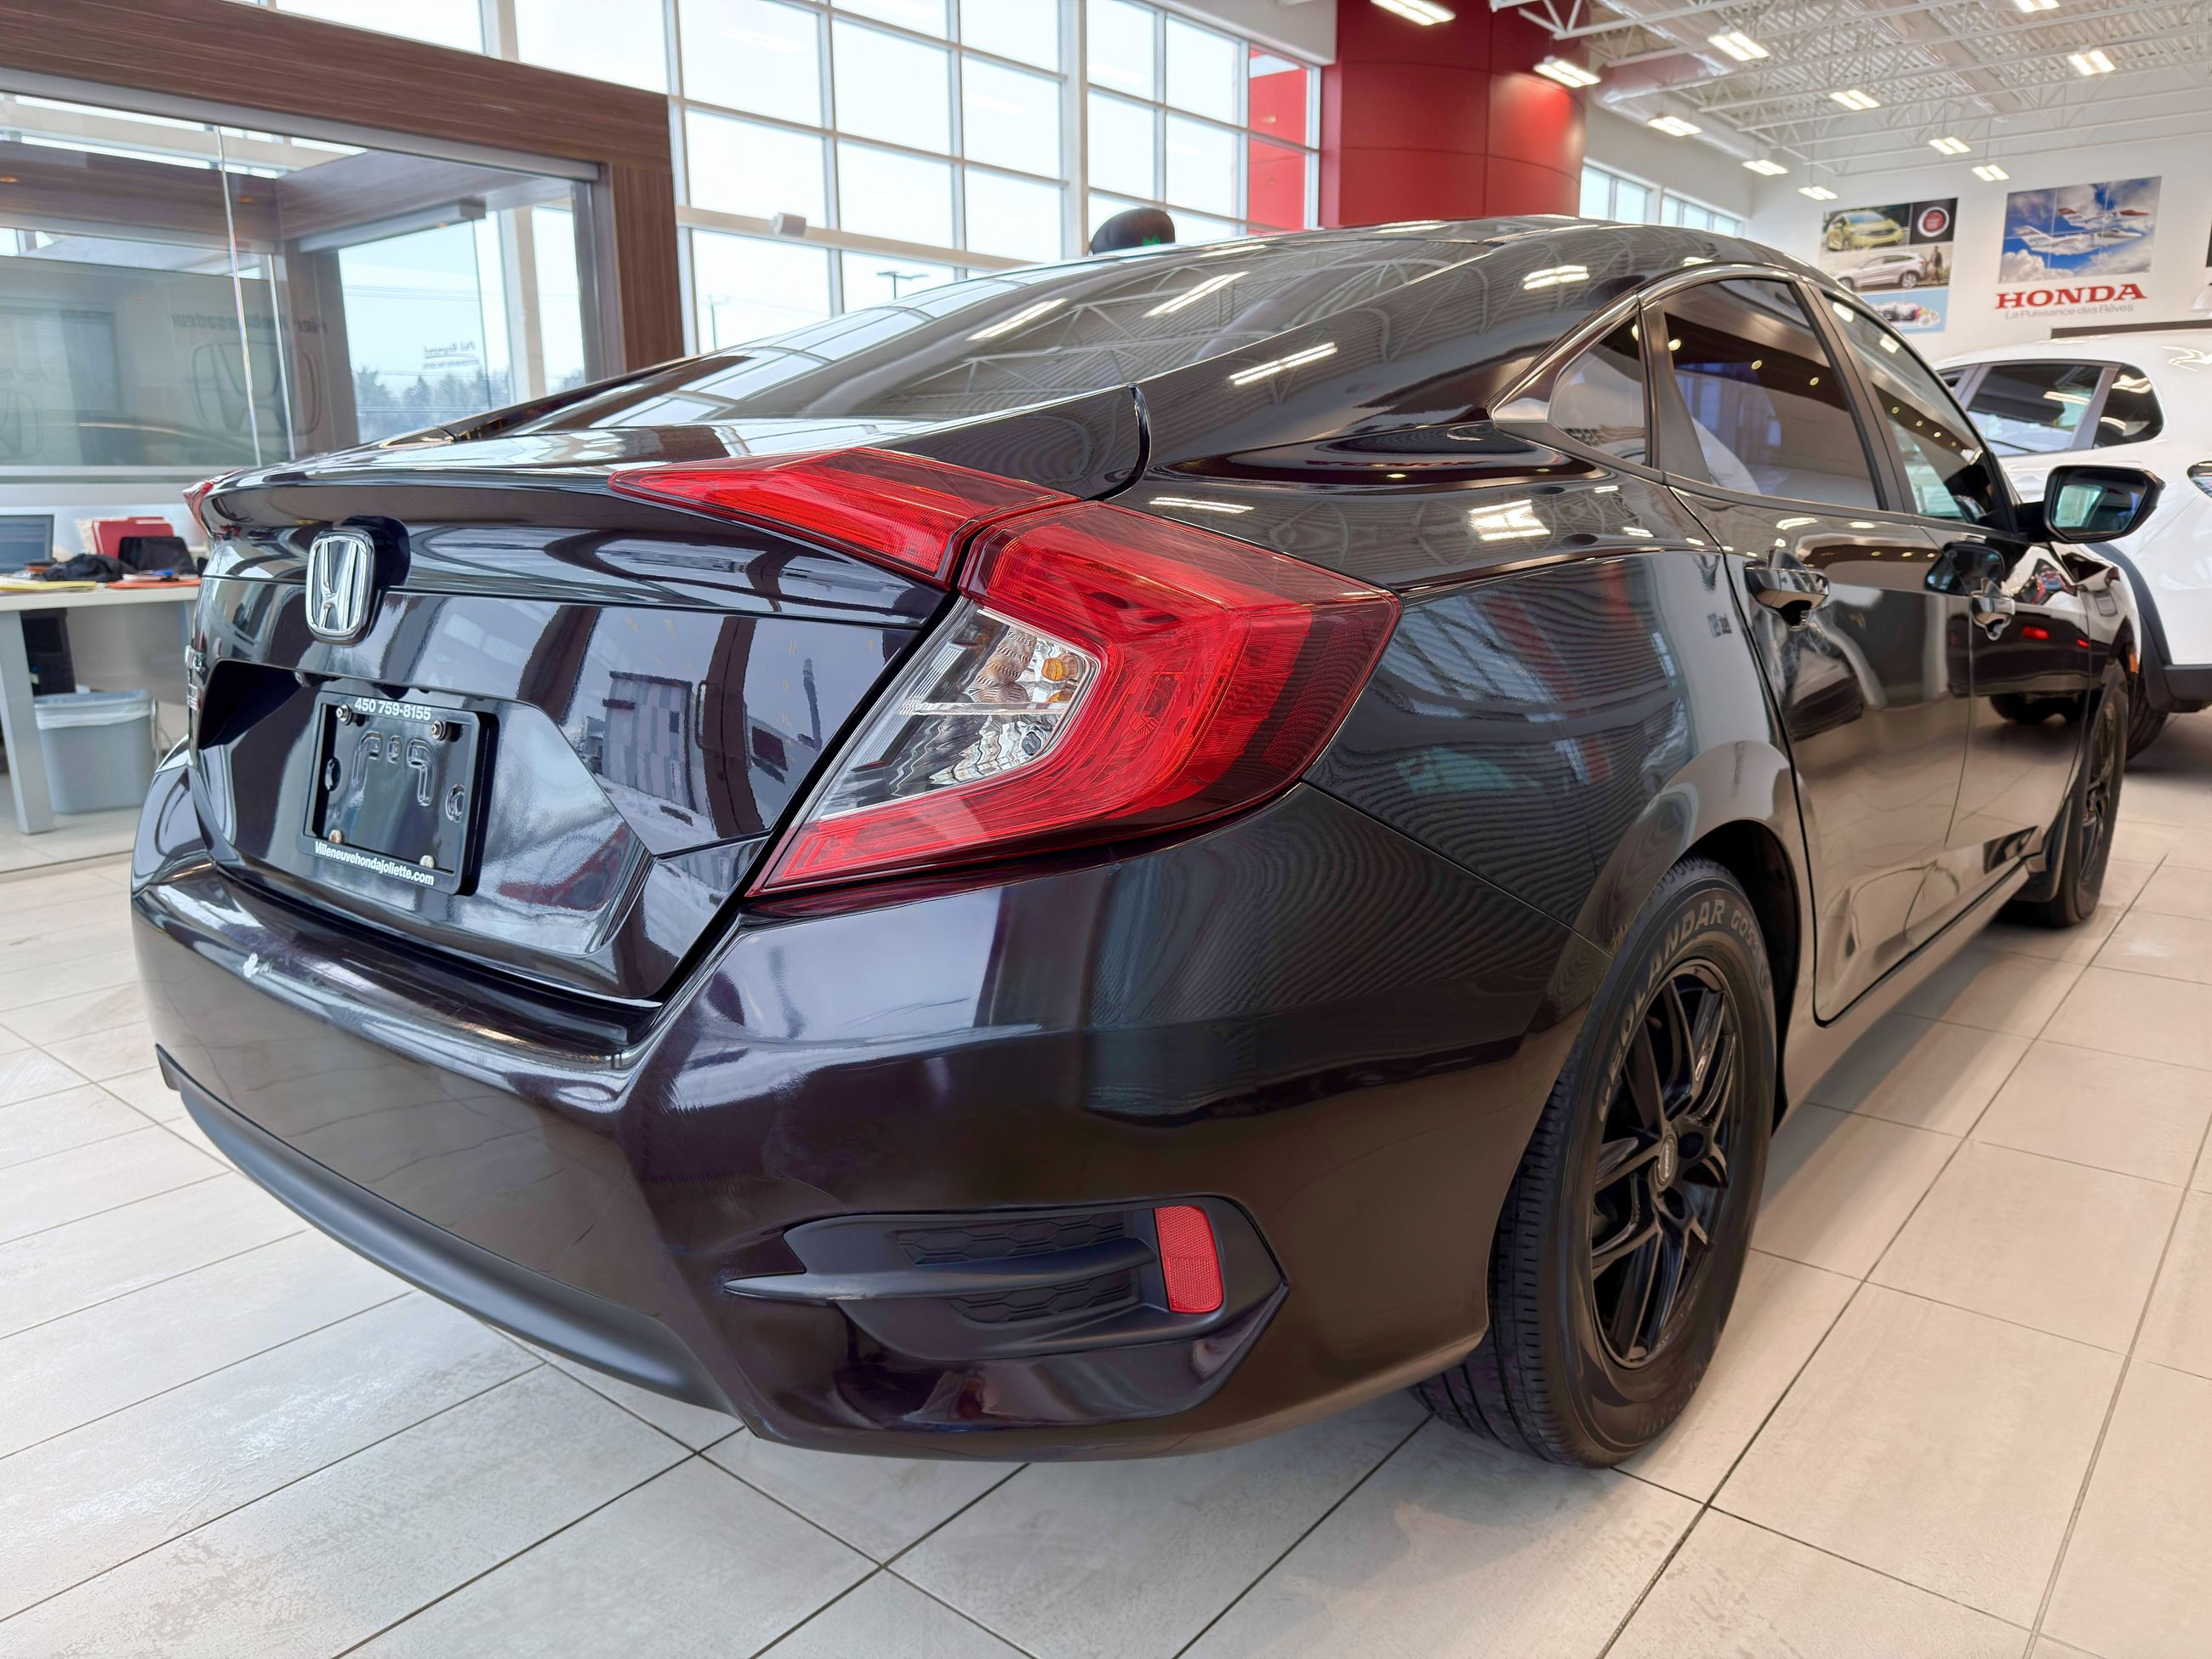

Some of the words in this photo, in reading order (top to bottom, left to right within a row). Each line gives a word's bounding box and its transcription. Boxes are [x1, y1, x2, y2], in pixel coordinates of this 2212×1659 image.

[1995, 283, 2147, 309] HONDA
[2005, 310, 2019, 320] La
[2021, 308, 2075, 319] Puissance
[2077, 305, 2098, 315] des
[354, 697, 376, 712] 450
[377, 699, 432, 721] 759-8155
[315, 841, 434, 886] Villeneuvehondajoliette.com
